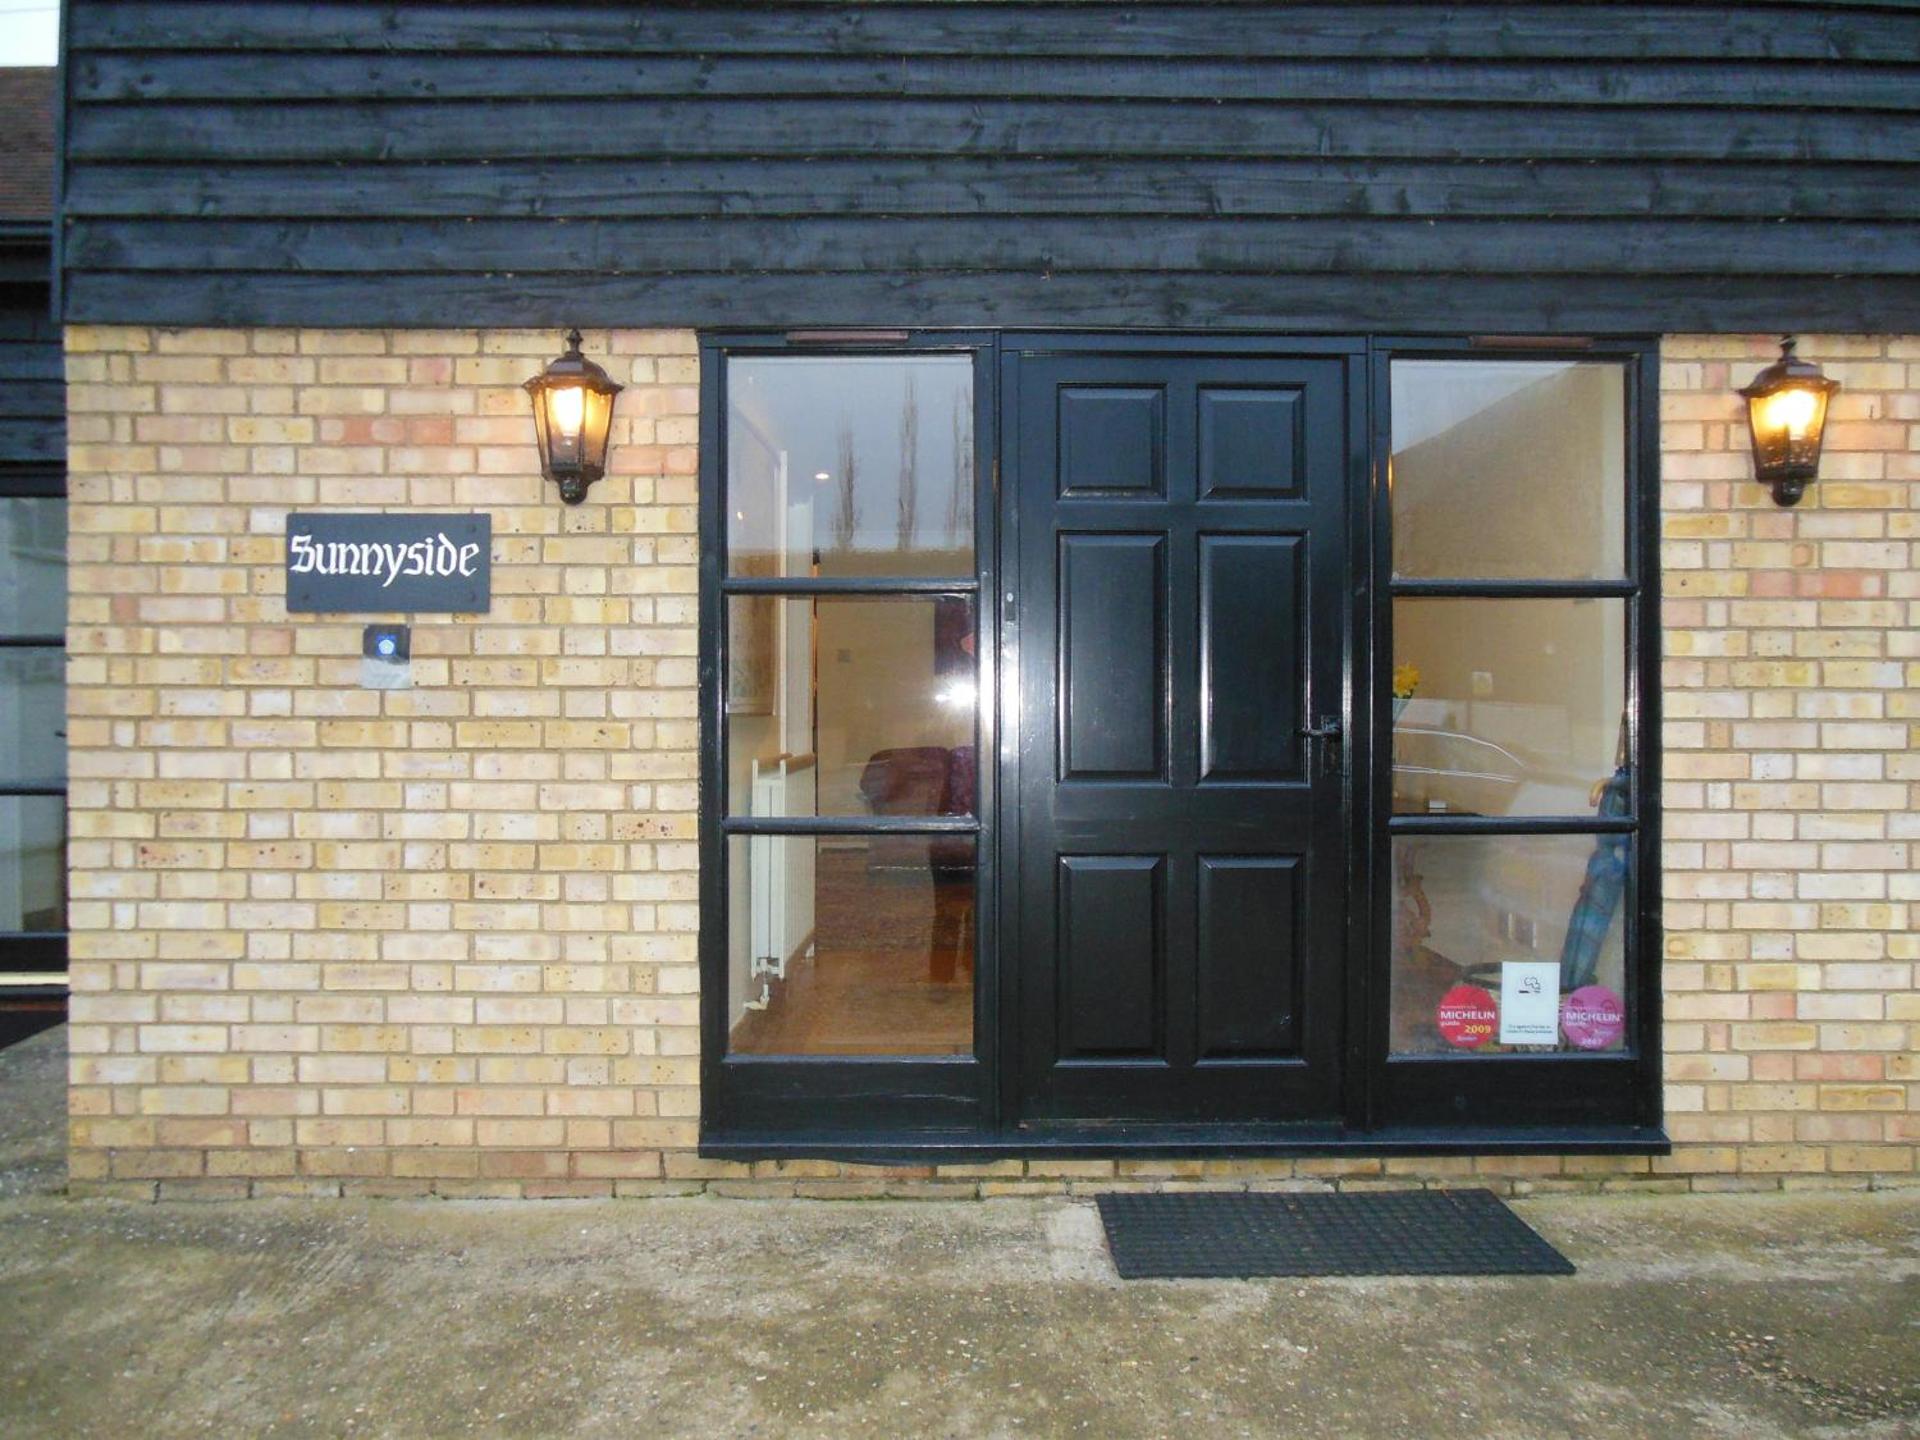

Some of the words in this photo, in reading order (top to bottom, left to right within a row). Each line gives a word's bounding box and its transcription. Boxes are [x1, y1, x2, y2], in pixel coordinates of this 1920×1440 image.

[290, 532, 480, 588] Sunnyside
[1440, 1010, 1496, 1020] MICHELIN
[1566, 1011, 1621, 1022] MICHELIN
[1464, 1024, 1492, 1034] 2009
